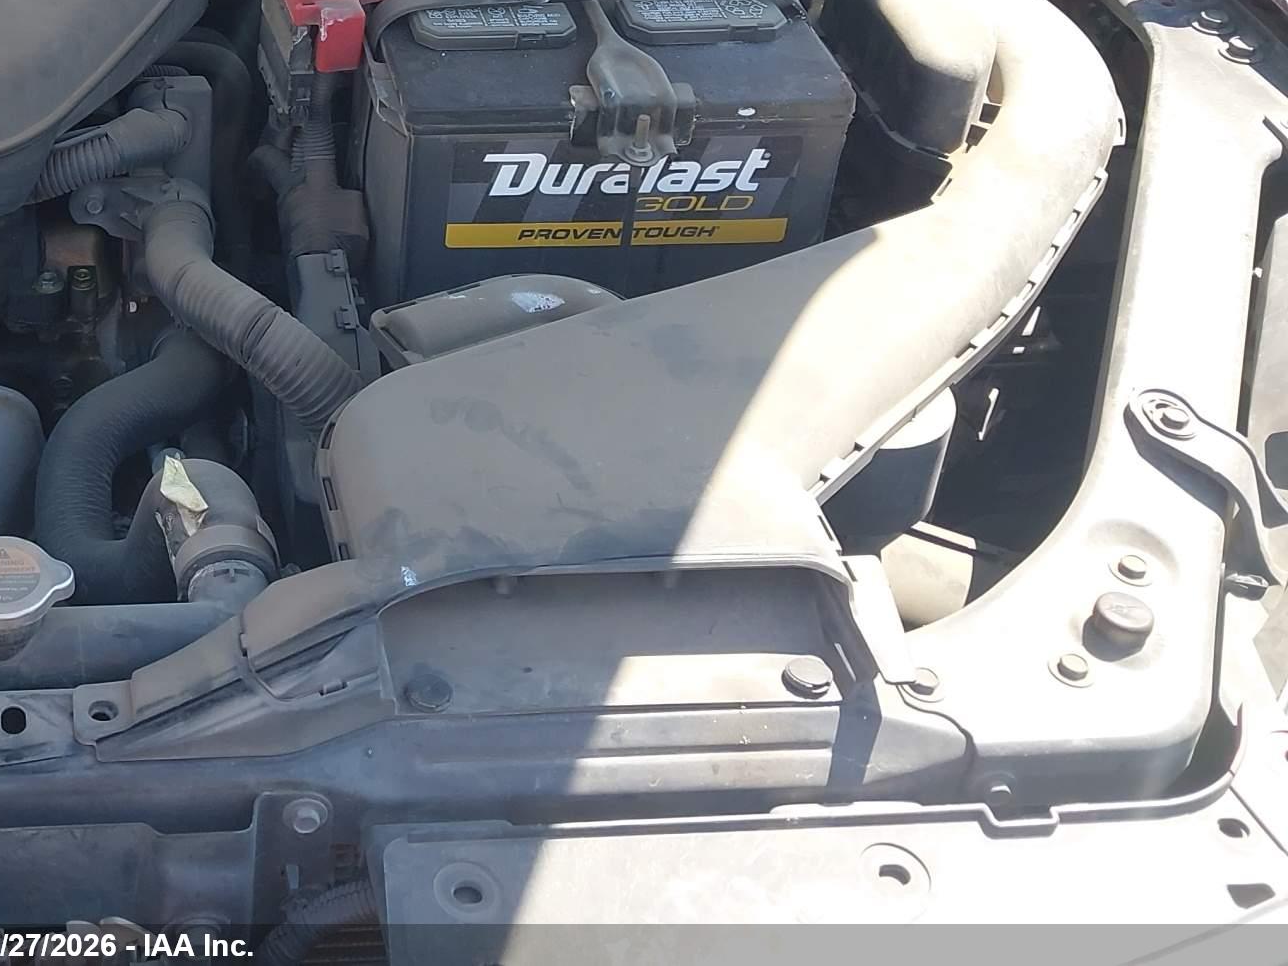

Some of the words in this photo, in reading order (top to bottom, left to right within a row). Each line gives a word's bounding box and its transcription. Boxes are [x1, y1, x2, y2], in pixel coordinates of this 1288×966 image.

[634, 195, 753, 213] GOLD
[517, 228, 622, 241] PROVEN
[631, 225, 715, 239] TOUGH
